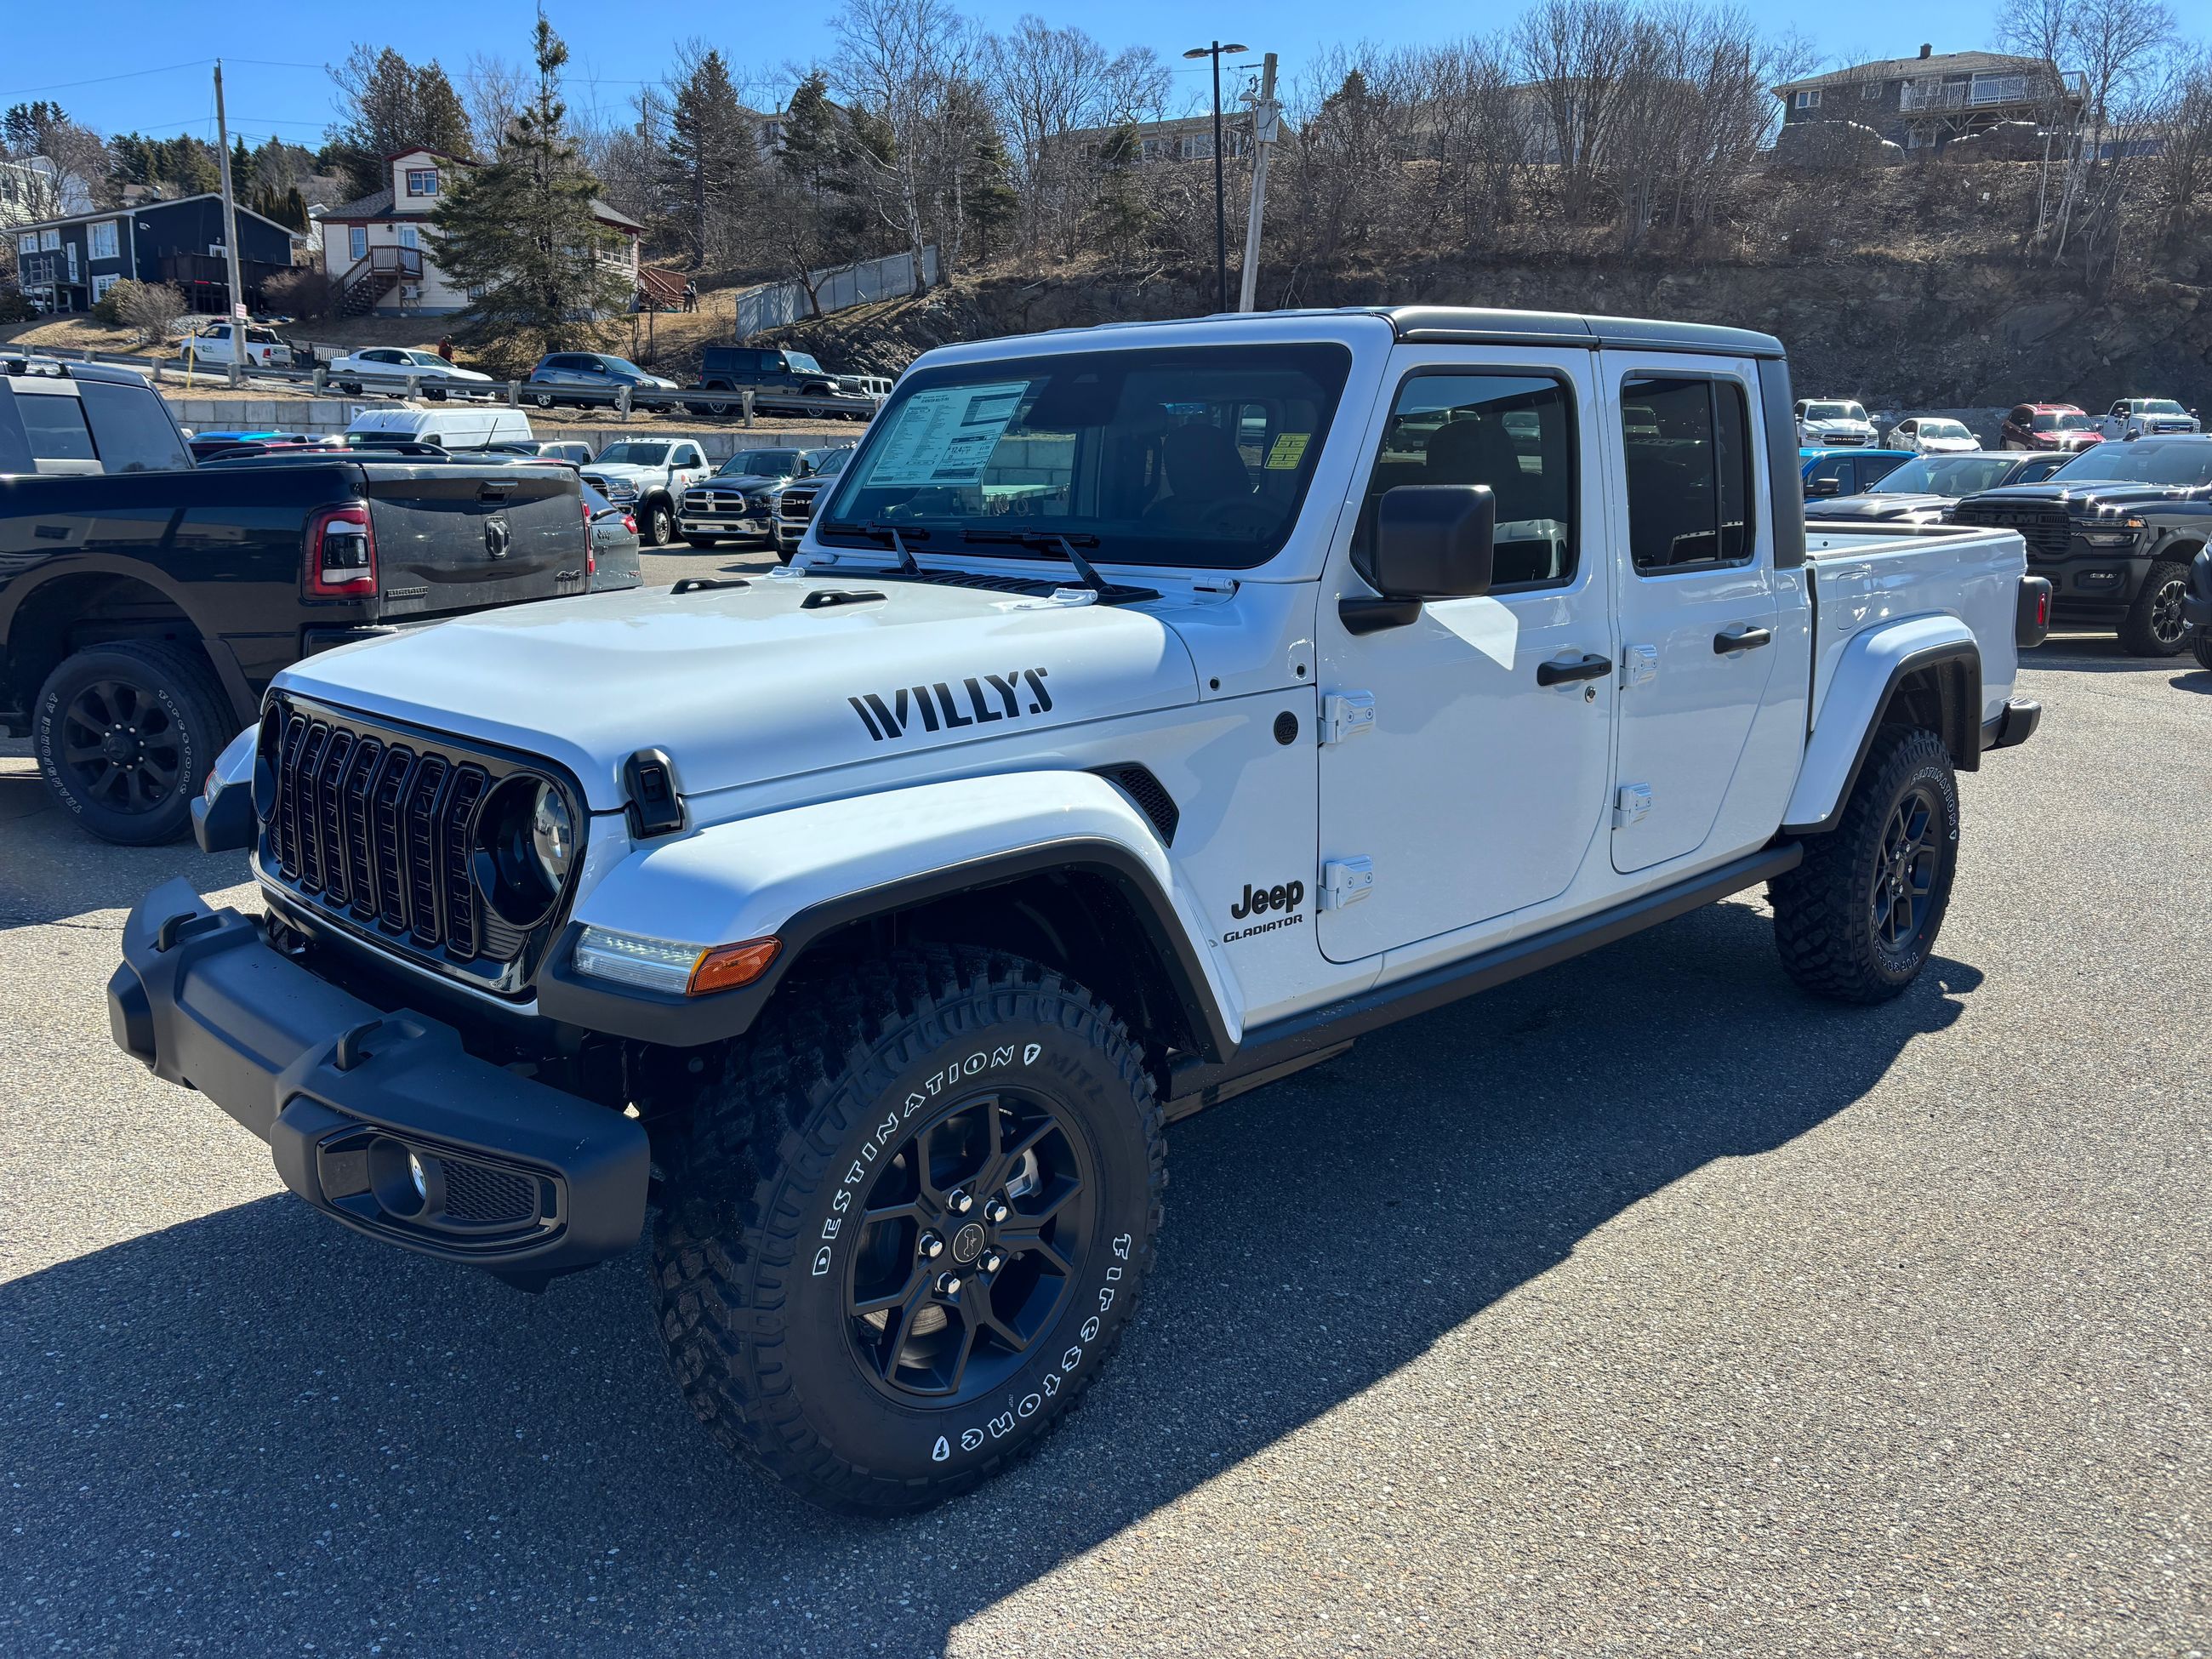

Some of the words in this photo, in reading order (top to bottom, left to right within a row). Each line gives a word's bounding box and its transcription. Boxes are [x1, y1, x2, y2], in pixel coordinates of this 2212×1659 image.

[1979, 513, 2037, 524] RAM
[46, 693, 59, 714] AT
[847, 667, 1053, 742] WILLYS
[40, 715, 83, 814] TRANSFORCE
[1910, 767, 1956, 826] DESTINATION
[1231, 880, 1304, 920] Jeep
[1223, 914, 1303, 943] GLADIATOR
[812, 1045, 1015, 1276] DESTINATION
